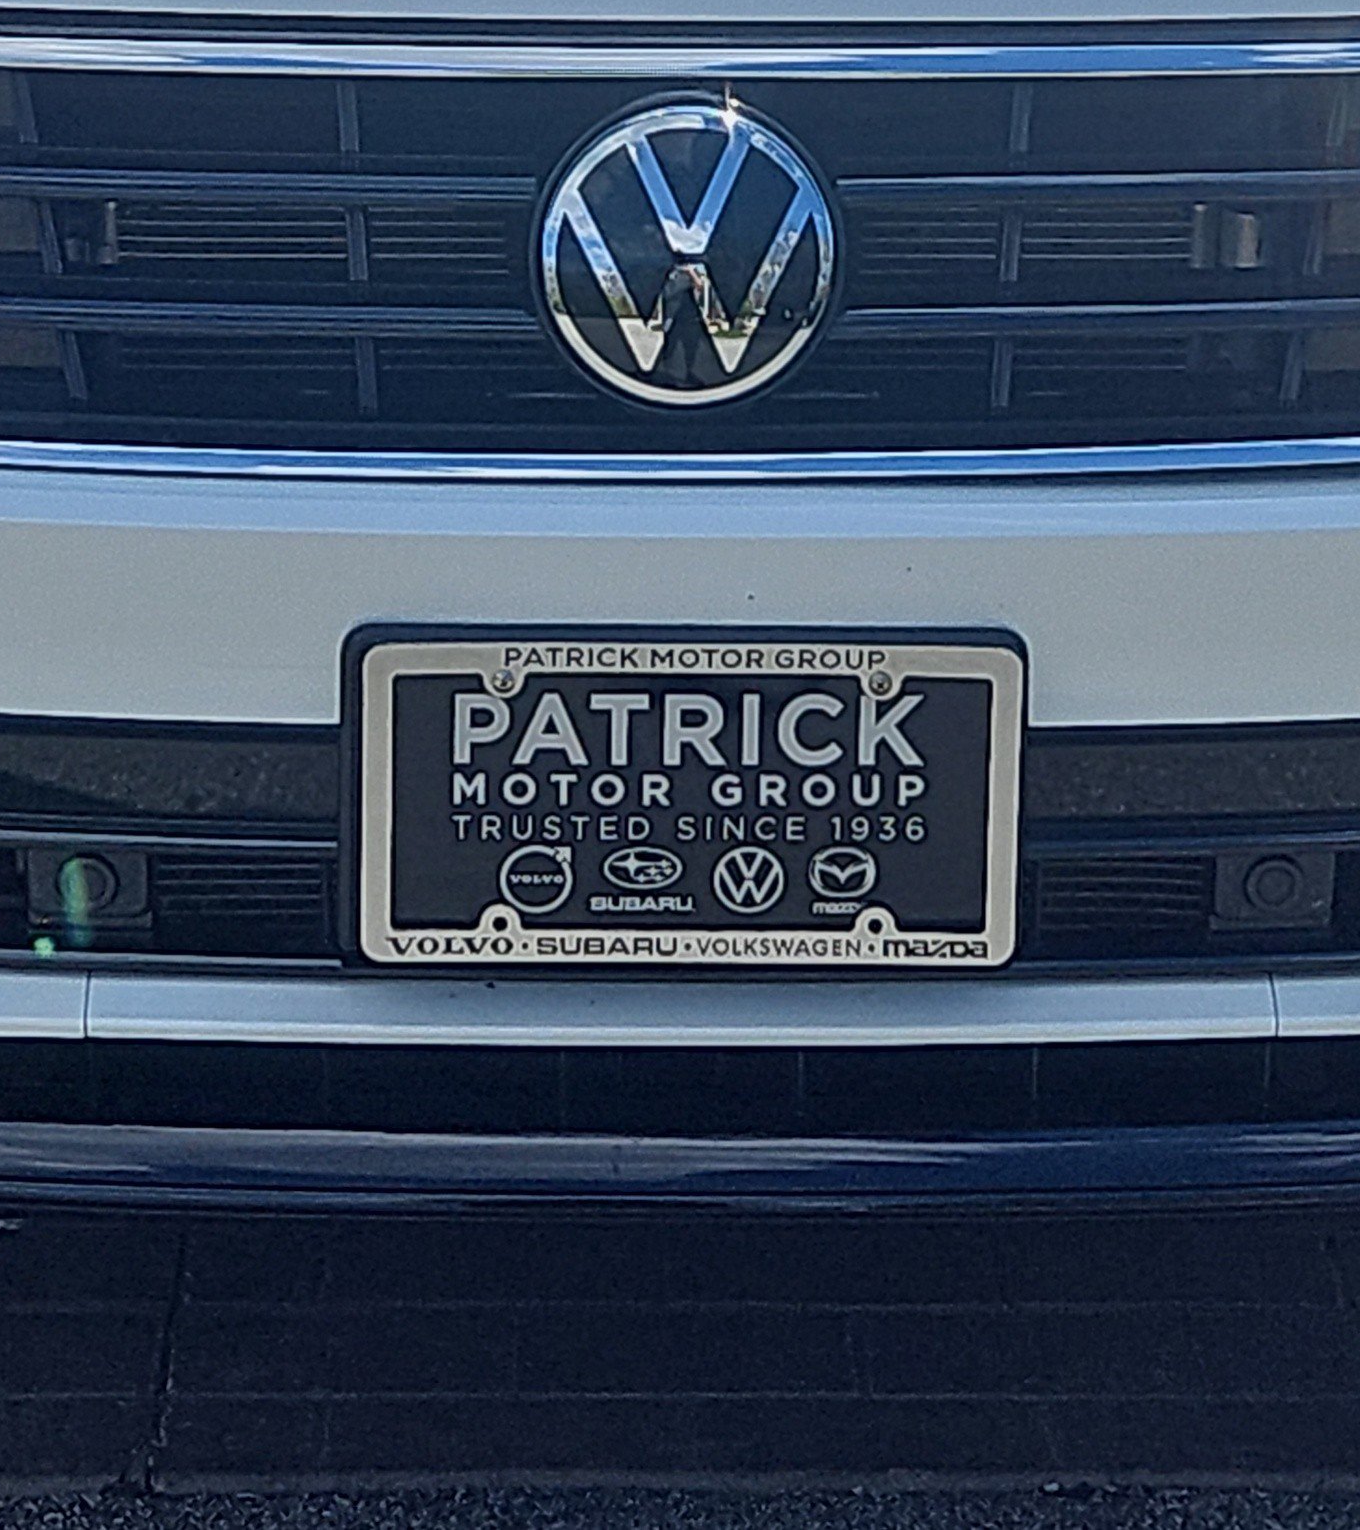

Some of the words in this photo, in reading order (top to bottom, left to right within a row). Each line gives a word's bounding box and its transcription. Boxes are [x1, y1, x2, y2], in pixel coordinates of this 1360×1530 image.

[504, 647, 639, 668] PATRICK
[650, 648, 765, 669] MOTOR
[774, 648, 886, 670] GROUP
[452, 691, 926, 767] PATRICK
[452, 772, 671, 807] MOTOR
[710, 773, 926, 807] GROUP
[451, 814, 651, 841] TRUSTED
[676, 816, 806, 841] SINCE
[830, 816, 926, 842] 1936
[509, 873, 565, 885] VOLVO
[590, 896, 693, 912] SUBARU
[386, 936, 514, 956] VOLVO
[536, 936, 678, 956] SUBARU
[696, 937, 862, 957] VOLKSWAGEN
[883, 939, 987, 959] mazda
